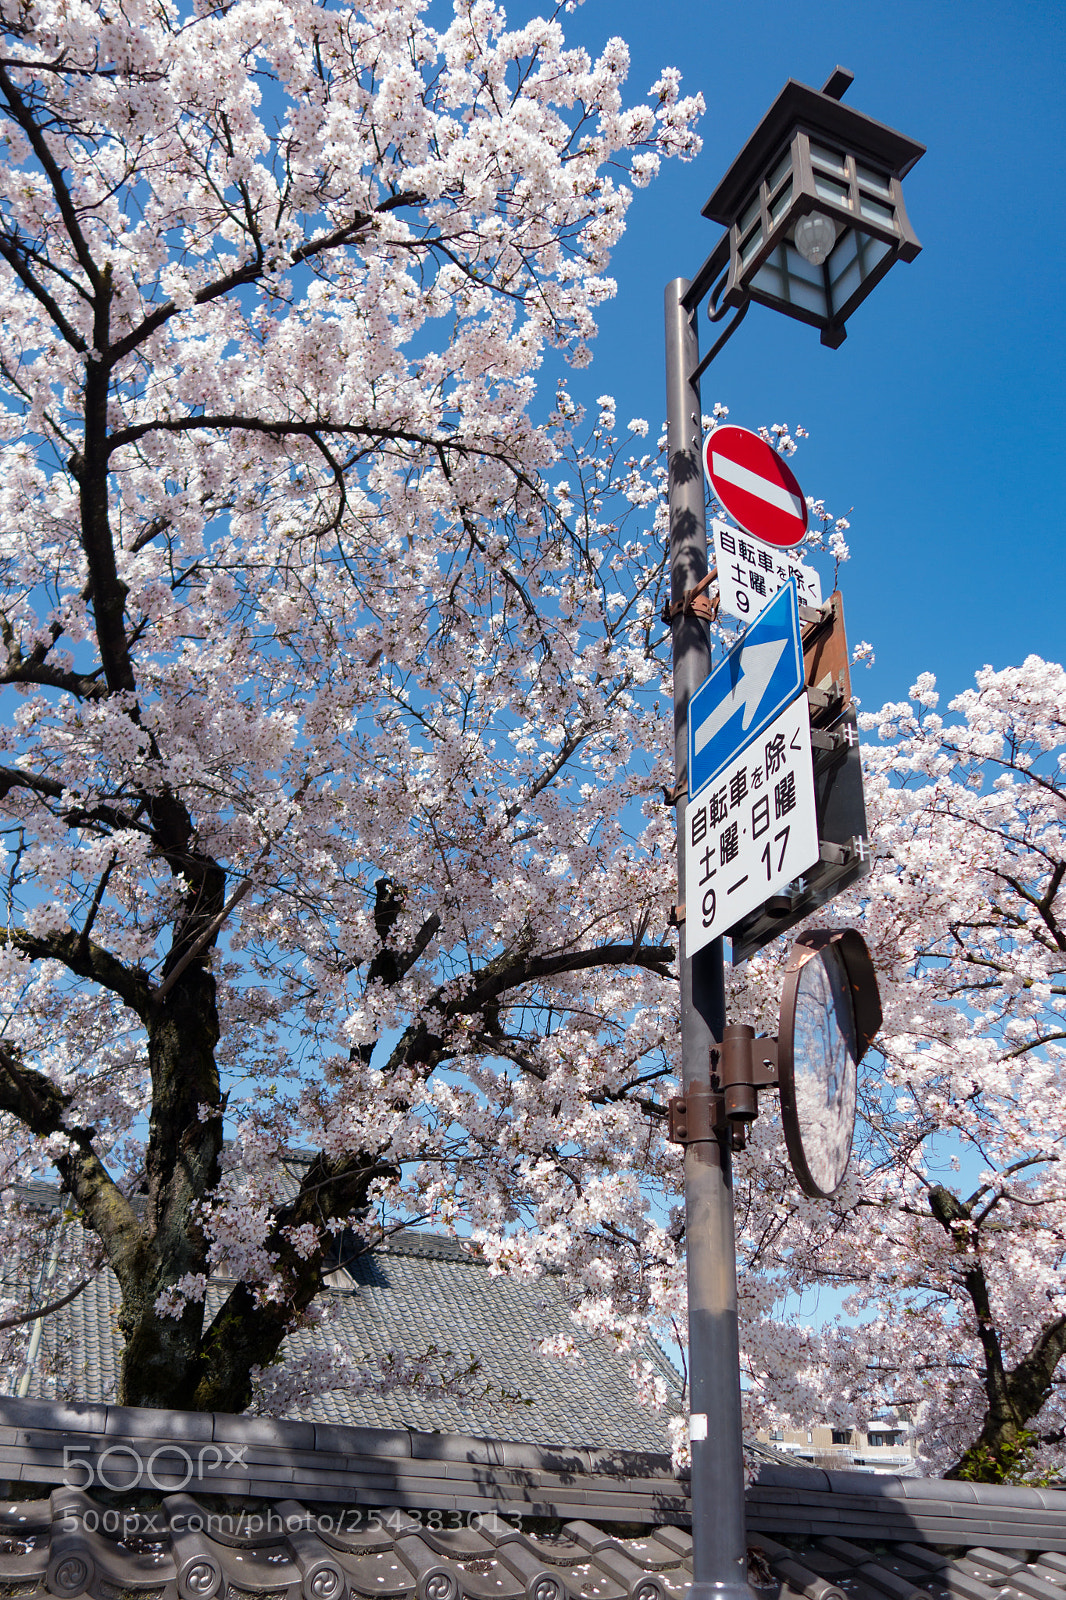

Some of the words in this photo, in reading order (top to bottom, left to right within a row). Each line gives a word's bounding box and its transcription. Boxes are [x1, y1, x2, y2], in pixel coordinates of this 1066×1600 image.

[720, 531, 817, 598] 自転車を除く
[736, 590, 750, 613] 9
[692, 727, 802, 847] 自転車を除く
[699, 770, 797, 886] 土曜・日曜
